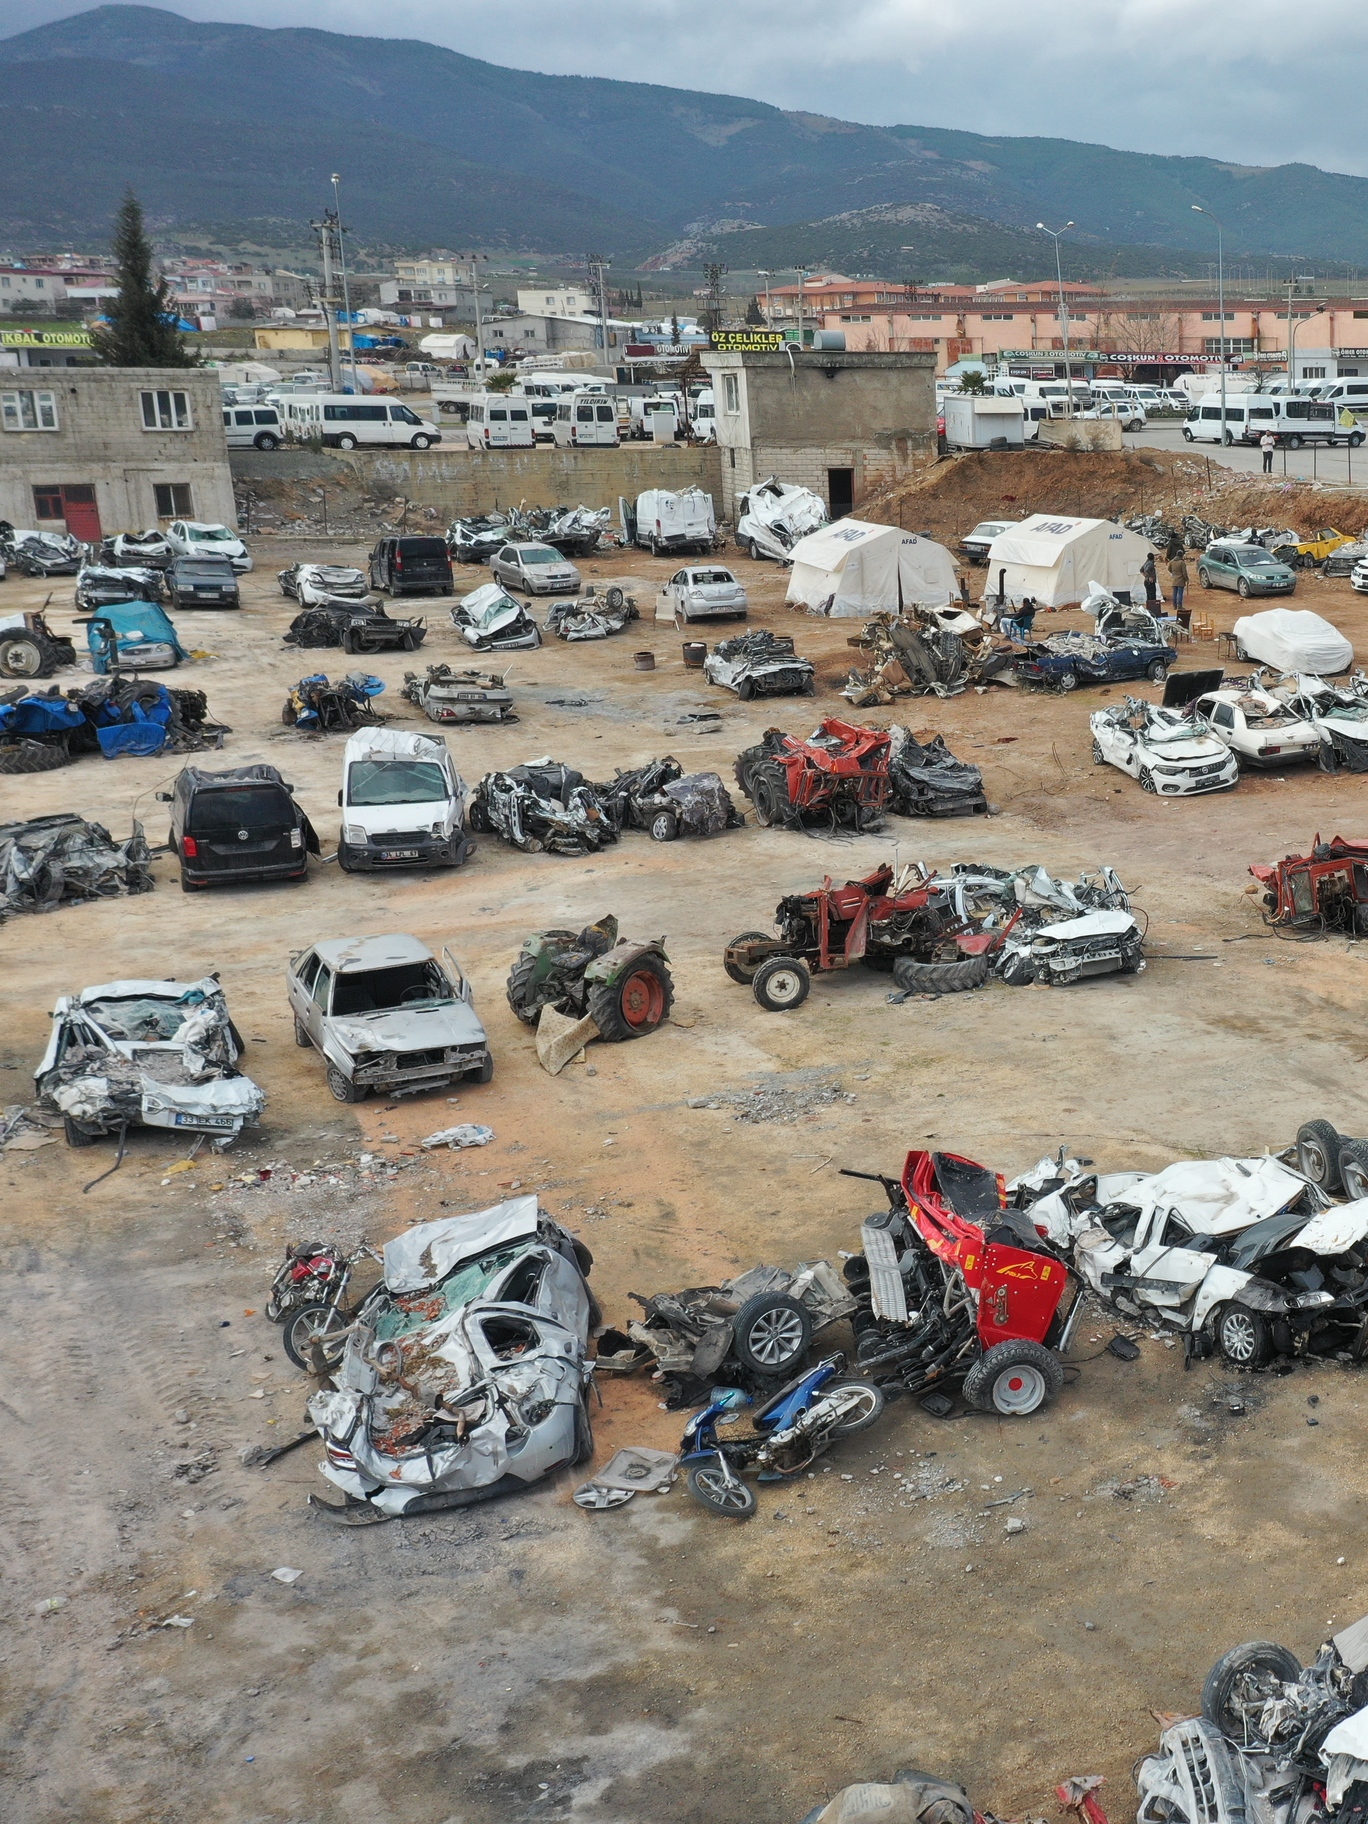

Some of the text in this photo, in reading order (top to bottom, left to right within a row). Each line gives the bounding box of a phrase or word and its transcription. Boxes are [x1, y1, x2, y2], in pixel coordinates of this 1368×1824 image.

[711, 332, 782, 343] ÖZ ÇELİKLER
[1030, 522, 1073, 534] AFAD
[183, 1115, 194, 1123] 33
